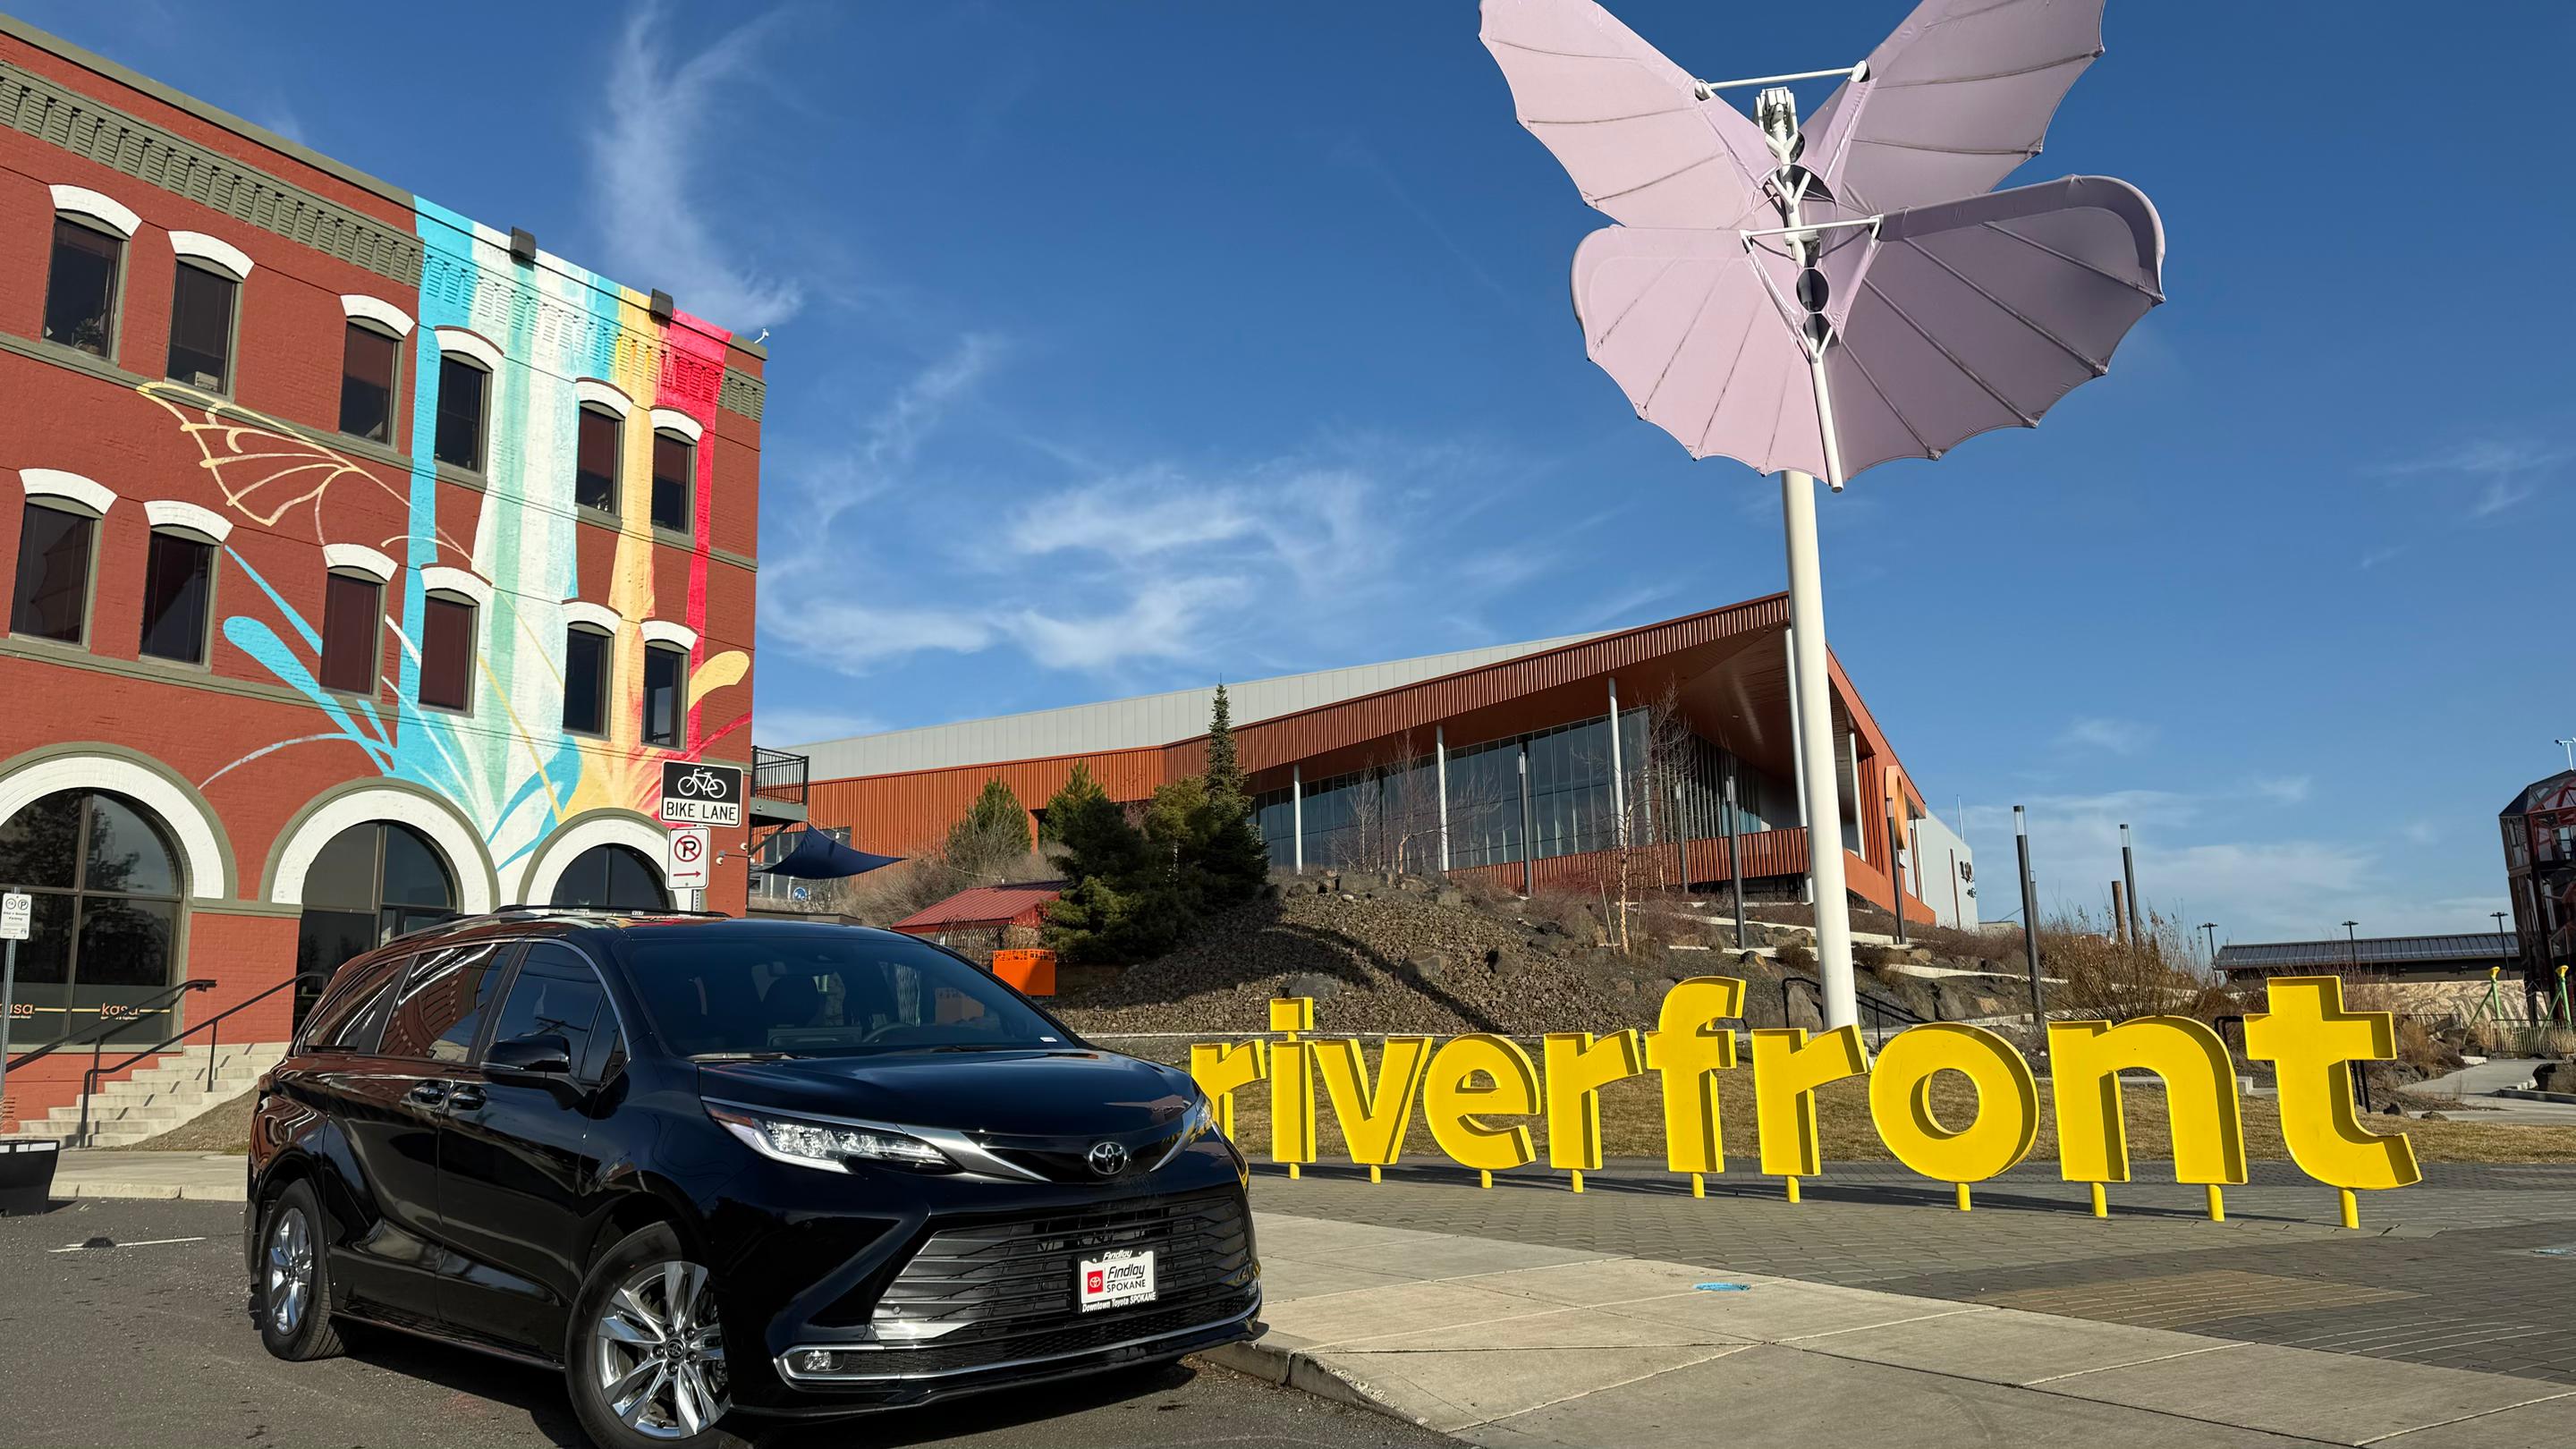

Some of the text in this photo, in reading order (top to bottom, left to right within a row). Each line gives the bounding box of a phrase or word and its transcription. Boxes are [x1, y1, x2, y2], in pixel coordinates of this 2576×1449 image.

[666, 801, 736, 821] BIKE LANE
[1191, 975, 2422, 1190] riverfront
[1103, 1250, 1132, 1260] Findlay
[1107, 1264, 1145, 1280] Findlay
[1106, 1279, 1146, 1293] SPOKANE
[1082, 1292, 1157, 1313] Downtown Toyota SPOKANE
